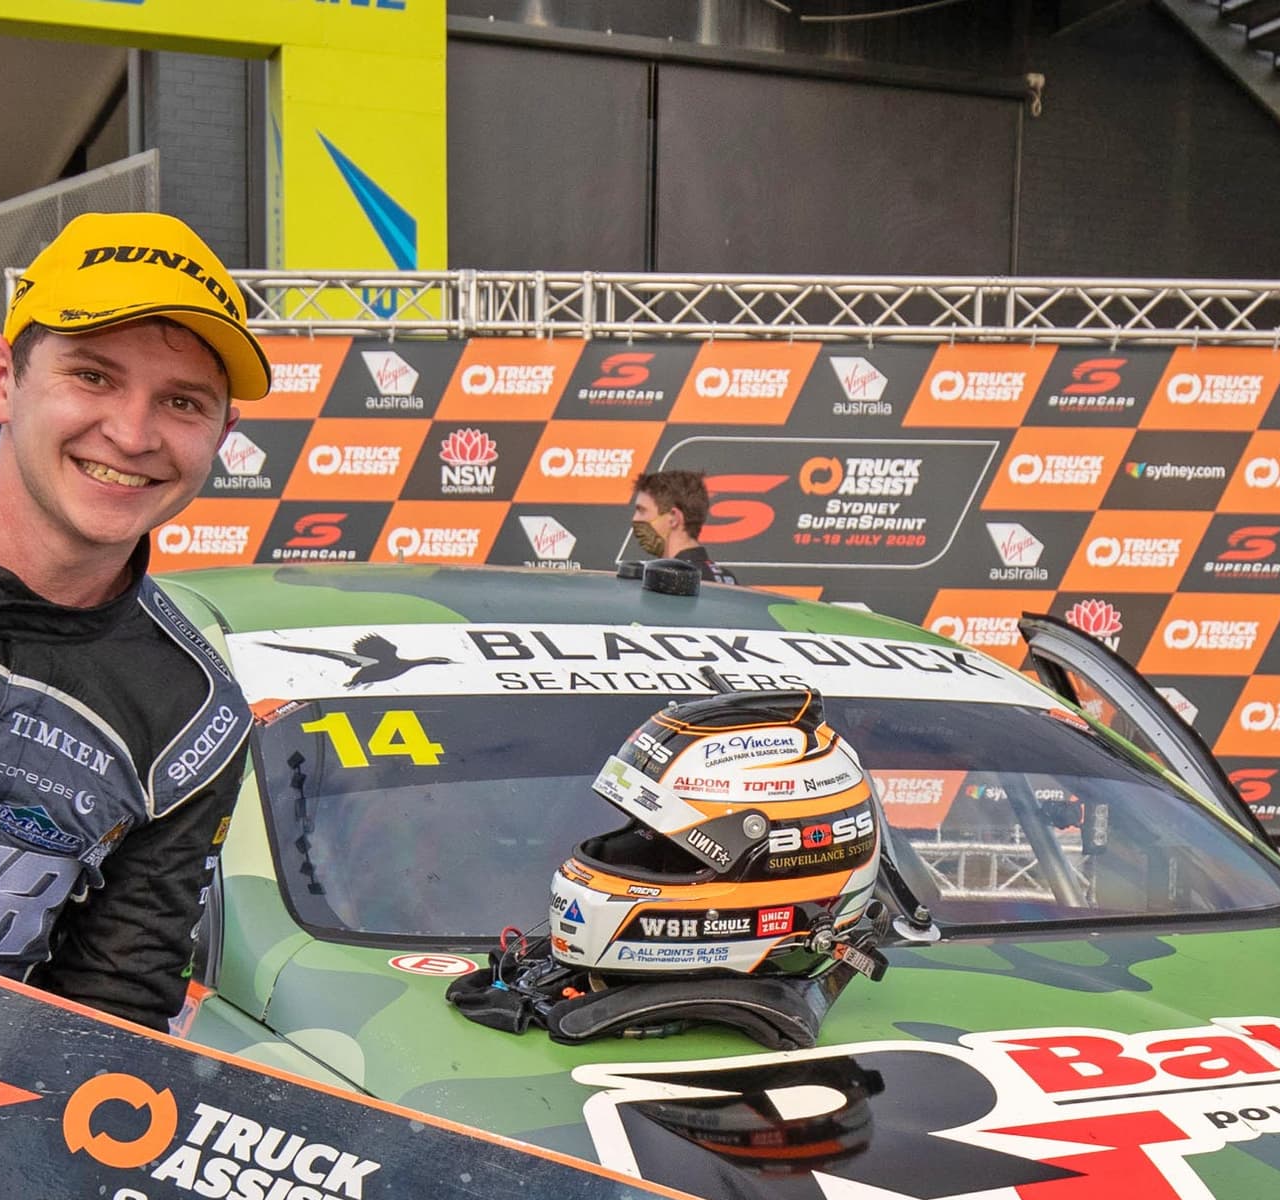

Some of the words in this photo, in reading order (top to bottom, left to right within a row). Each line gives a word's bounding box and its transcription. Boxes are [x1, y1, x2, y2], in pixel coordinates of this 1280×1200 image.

[377, 359, 412, 390] Virgin
[499, 366, 555, 379] TRUCK
[967, 372, 1025, 386] TRUCK
[845, 365, 881, 395] Virgin
[1205, 375, 1263, 389] TRUCK
[494, 380, 553, 395] ASSIST
[962, 386, 1023, 400] ASSIST
[579, 389, 663, 401] SUPERCARS
[1049, 396, 1135, 407] SUPERCARS
[1199, 389, 1261, 404] ASSIST
[366, 395, 423, 410] australia
[833, 401, 891, 416] australia
[345, 447, 402, 460] TRUCK
[578, 449, 634, 463] TRUCK
[341, 460, 401, 475] ASSIST
[572, 463, 633, 477] ASSIST
[845, 458, 922, 477] TRUCK
[1146, 463, 1225, 480] sydney.com
[214, 475, 271, 489] australia
[441, 466, 496, 484] NSW
[442, 486, 495, 494] GOVERNMENT
[840, 477, 919, 496] ASSIST
[826, 501, 900, 515] SYDNEY
[423, 529, 480, 542] TRUCK
[846, 533, 880, 545] JULY
[886, 535, 925, 545] 2020
[418, 542, 475, 556] ASSIST
[1001, 530, 1034, 559] Virgin
[1122, 539, 1181, 553] TRUCK
[273, 549, 356, 559] SUPERCARS
[1116, 553, 1179, 568] ASSIST
[989, 567, 1048, 581] australia
[1201, 622, 1259, 636] TRUCK
[160, 600, 228, 673] FREIGHTLINER
[1194, 636, 1257, 650] ASSIST
[467, 631, 784, 663] BLACK
[783, 637, 1004, 679] DUCK
[496, 671, 810, 692] SEATCOVERS
[10, 712, 115, 776] TIMKEN
[168, 706, 233, 780] sparco
[300, 710, 445, 768] 14
[704, 743, 726, 759] Pt
[729, 736, 794, 749] Vincent
[705, 756, 733, 768] CARAVAN
[675, 777, 730, 787] ALDOM
[770, 849, 845, 869] SURVEILLANCE
[849, 841, 873, 856] SYSTE
[762, 912, 789, 922] UNICO
[704, 919, 750, 931] SCHULZ
[637, 955, 694, 963] Thomastown
[697, 955, 712, 963] Pty
[186, 1103, 381, 1200] TRUCK
